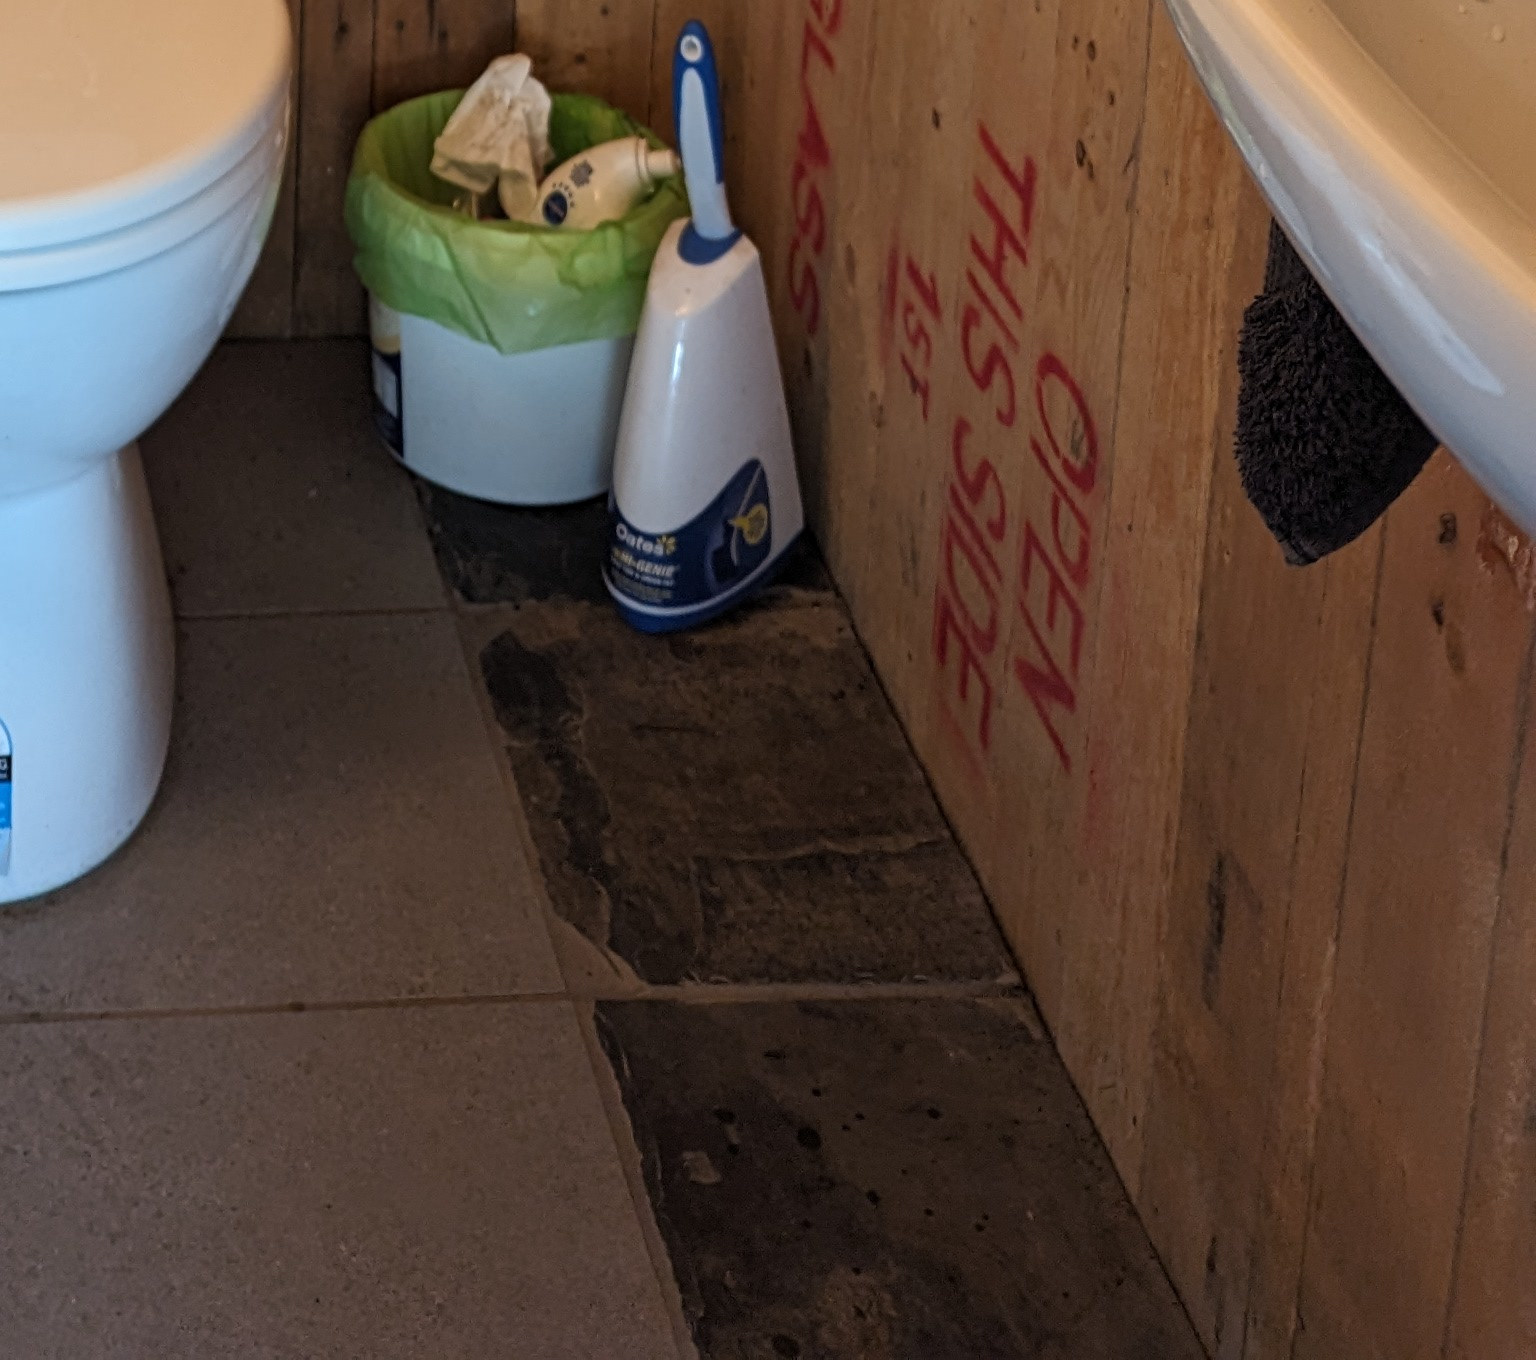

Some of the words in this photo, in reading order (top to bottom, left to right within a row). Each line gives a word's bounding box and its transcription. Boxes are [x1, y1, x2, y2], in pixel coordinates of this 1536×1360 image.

[963, 122, 1038, 428] THIS
[934, 416, 1006, 751] SIDE
[1014, 351, 1099, 775] OPEN
